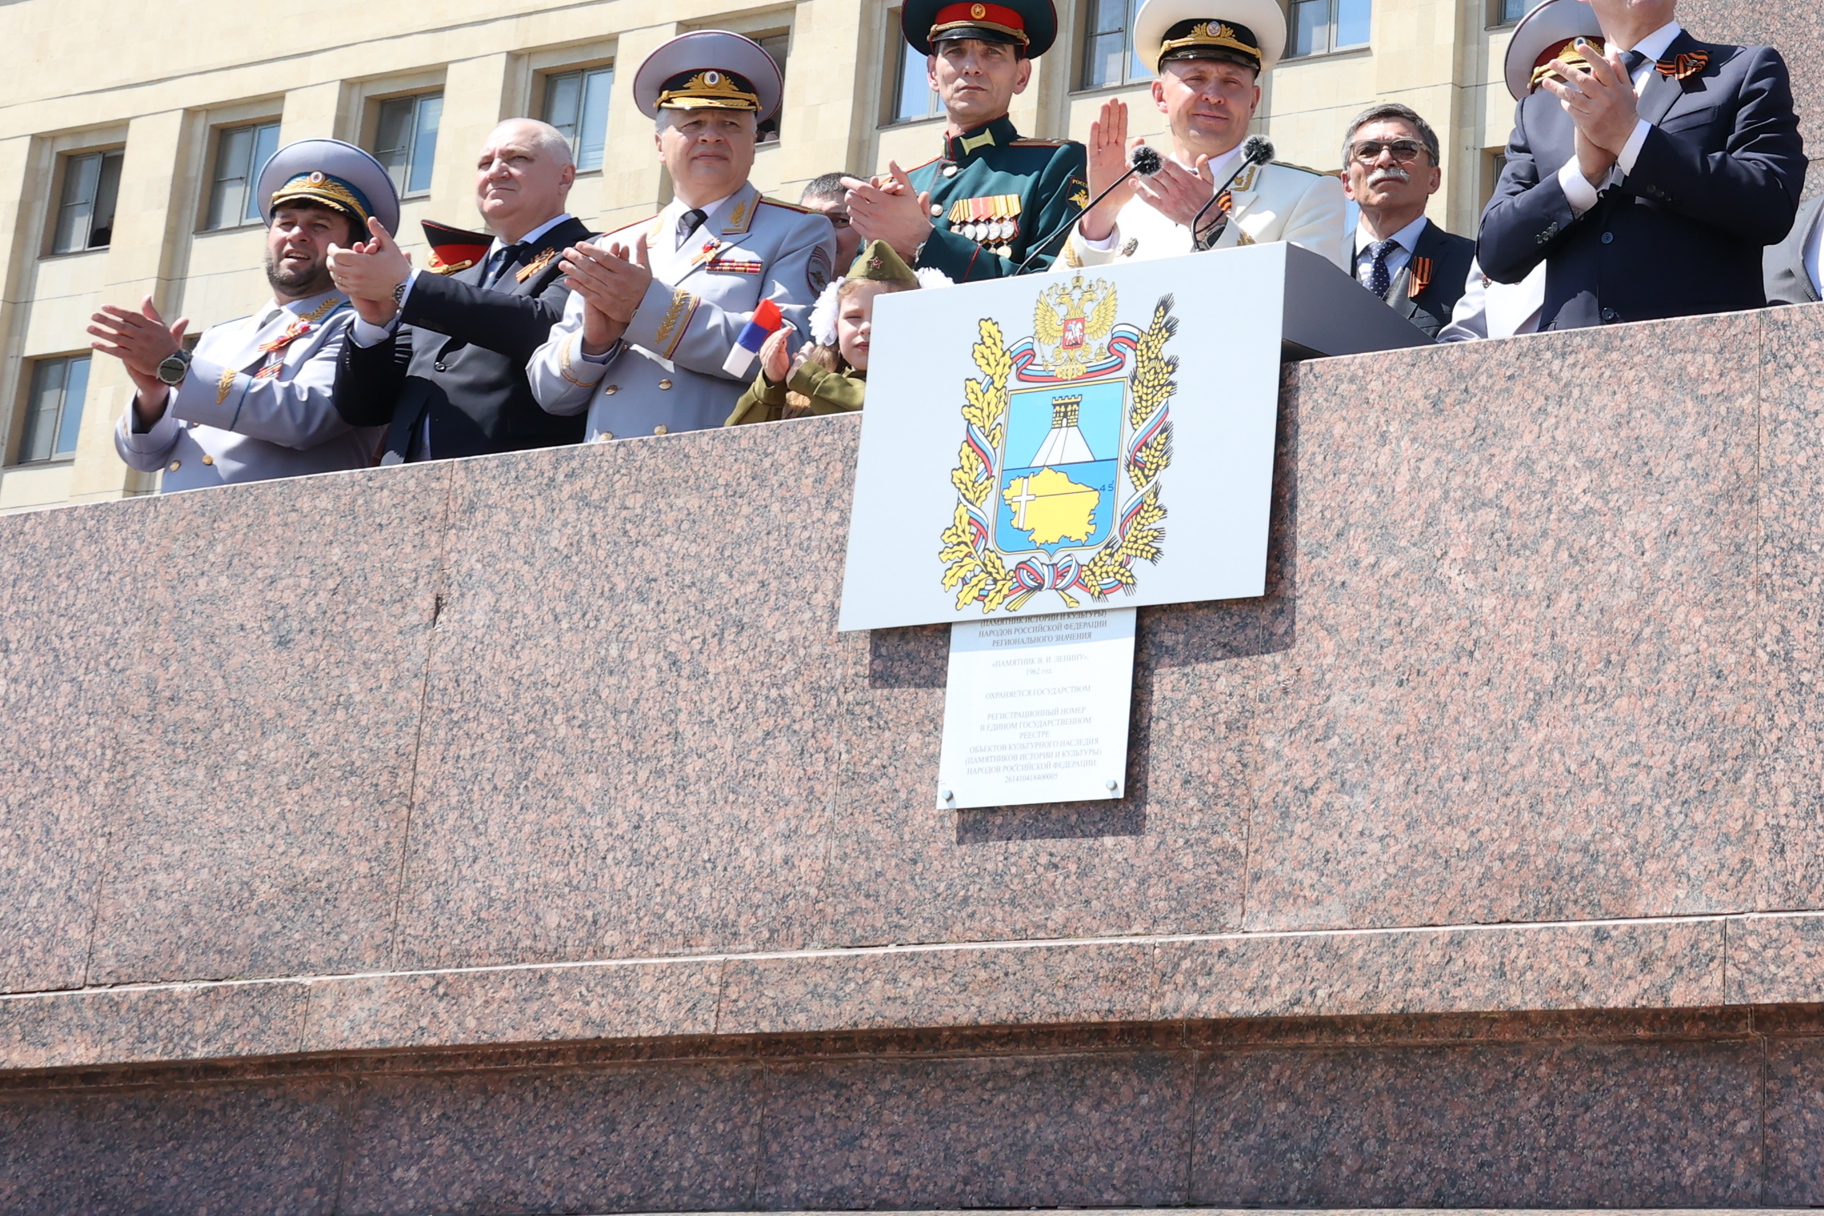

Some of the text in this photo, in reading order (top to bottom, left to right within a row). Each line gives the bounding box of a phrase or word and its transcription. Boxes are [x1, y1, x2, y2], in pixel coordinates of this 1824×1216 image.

[978, 620, 1107, 638] НАРОДОВ РОССИЙСКОЙ ФЕДЕРАЦИИ
[992, 632, 1092, 647] РЕГИОНАЛЬНОГО ЗНАЧЕНИЯ
[992, 657, 1035, 668] «ПАМЯТНИК
[1026, 667, 1040, 676] 1962
[985, 685, 1091, 700] ОХРАНЯЕТСЯ ГОСУДАРСТВОМ
[987, 706, 1086, 720] РЕГИСТРАЦИОННЫЙ НОМЕР
[986, 722, 1018, 731] ЕДИНОМ
[1019, 717, 1092, 729] ГОСУДАРСТВЕННОМ
[1019, 730, 1050, 739] РЕЕСТРЕ
[969, 738, 1099, 753] ОБЪЕКТОВ КУЛЬТУРНОГО НАСЛЕДИЯ
[965, 754, 1018, 766] (ПАМЯТНИКОВ
[1019, 752, 1054, 761] ИСТОРИИ
[1062, 748, 1102, 758] КУЛЬТУРЫ)
[967, 765, 1001, 775] НАРОДОВ
[1002, 761, 1052, 772] РОССИЙСКОЙ
